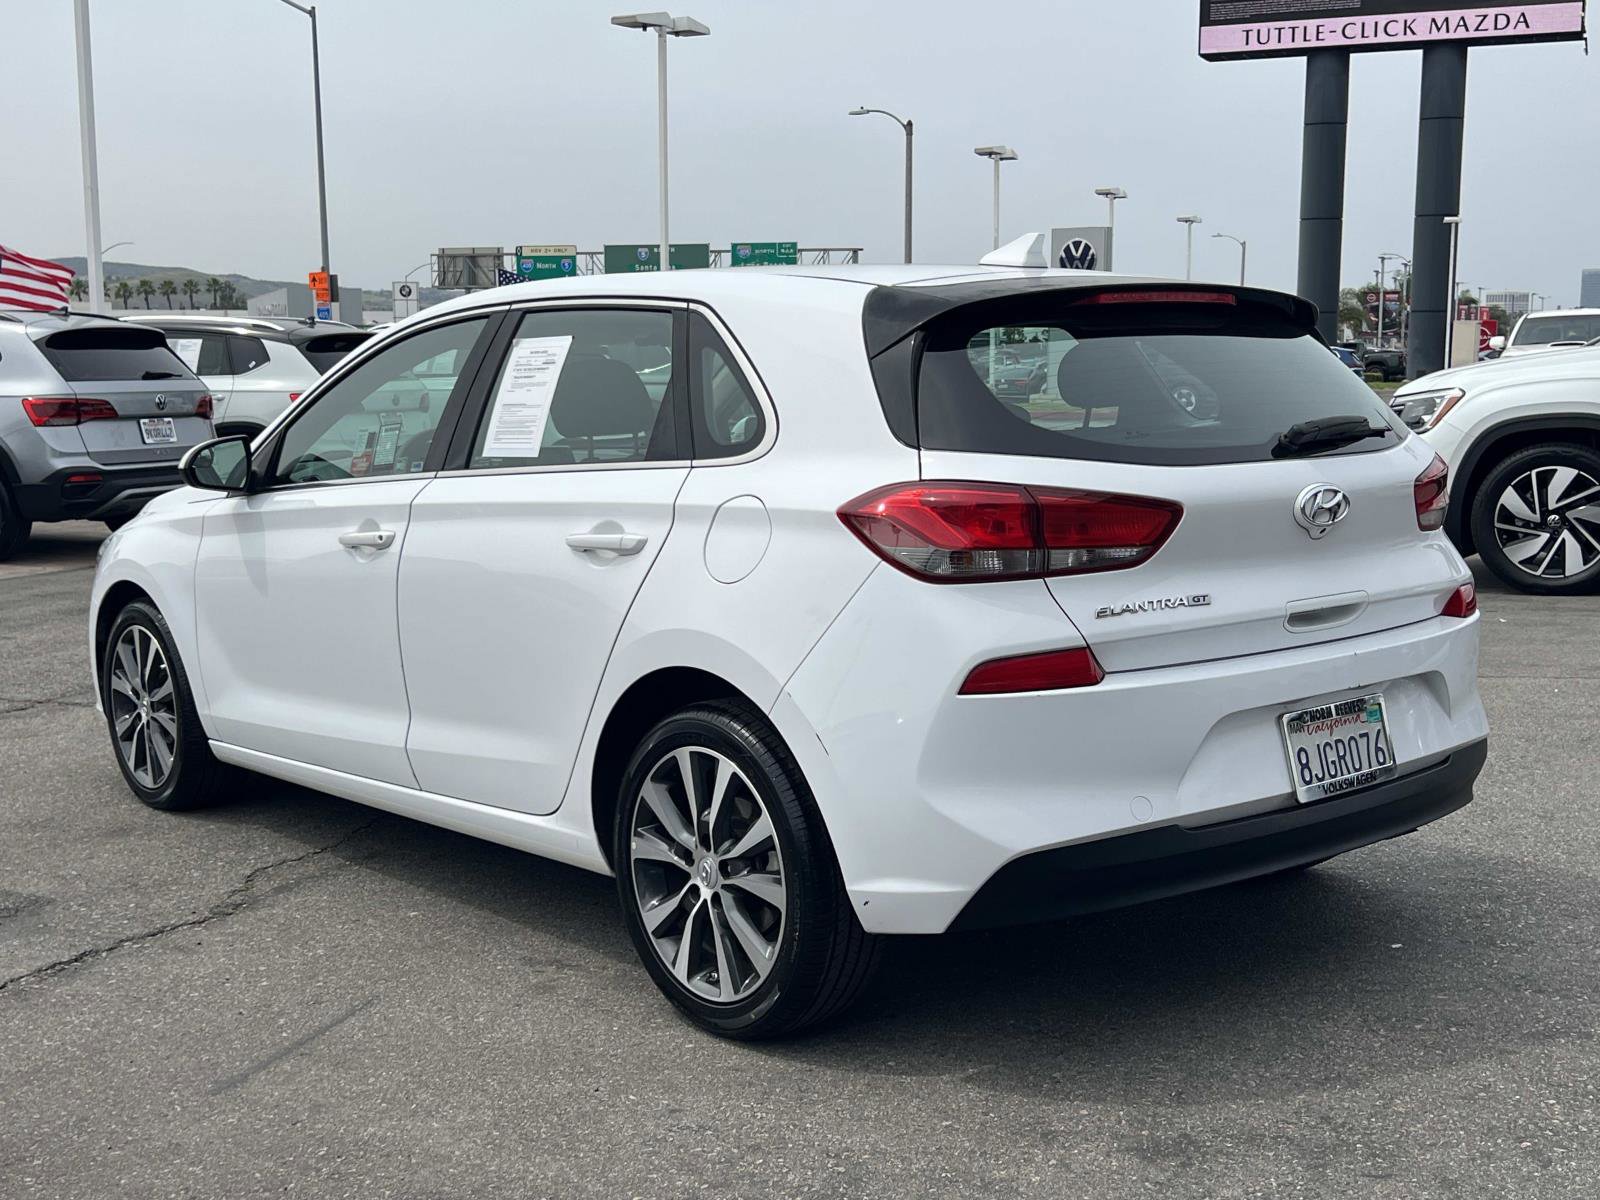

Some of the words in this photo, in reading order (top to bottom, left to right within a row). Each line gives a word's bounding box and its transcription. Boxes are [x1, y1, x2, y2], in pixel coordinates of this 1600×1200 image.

[1242, 18, 1417, 46] TUTTLE-CLICK
[1428, 11, 1531, 35] MAZDA
[1095, 595, 1188, 619] ELANTRA
[1191, 594, 1209, 604] GT
[1306, 713, 1365, 736] California
[1309, 705, 1334, 722] NORM
[1296, 728, 1387, 786] 8JGR076
[1322, 770, 1378, 795] VOLKSWAGEN
